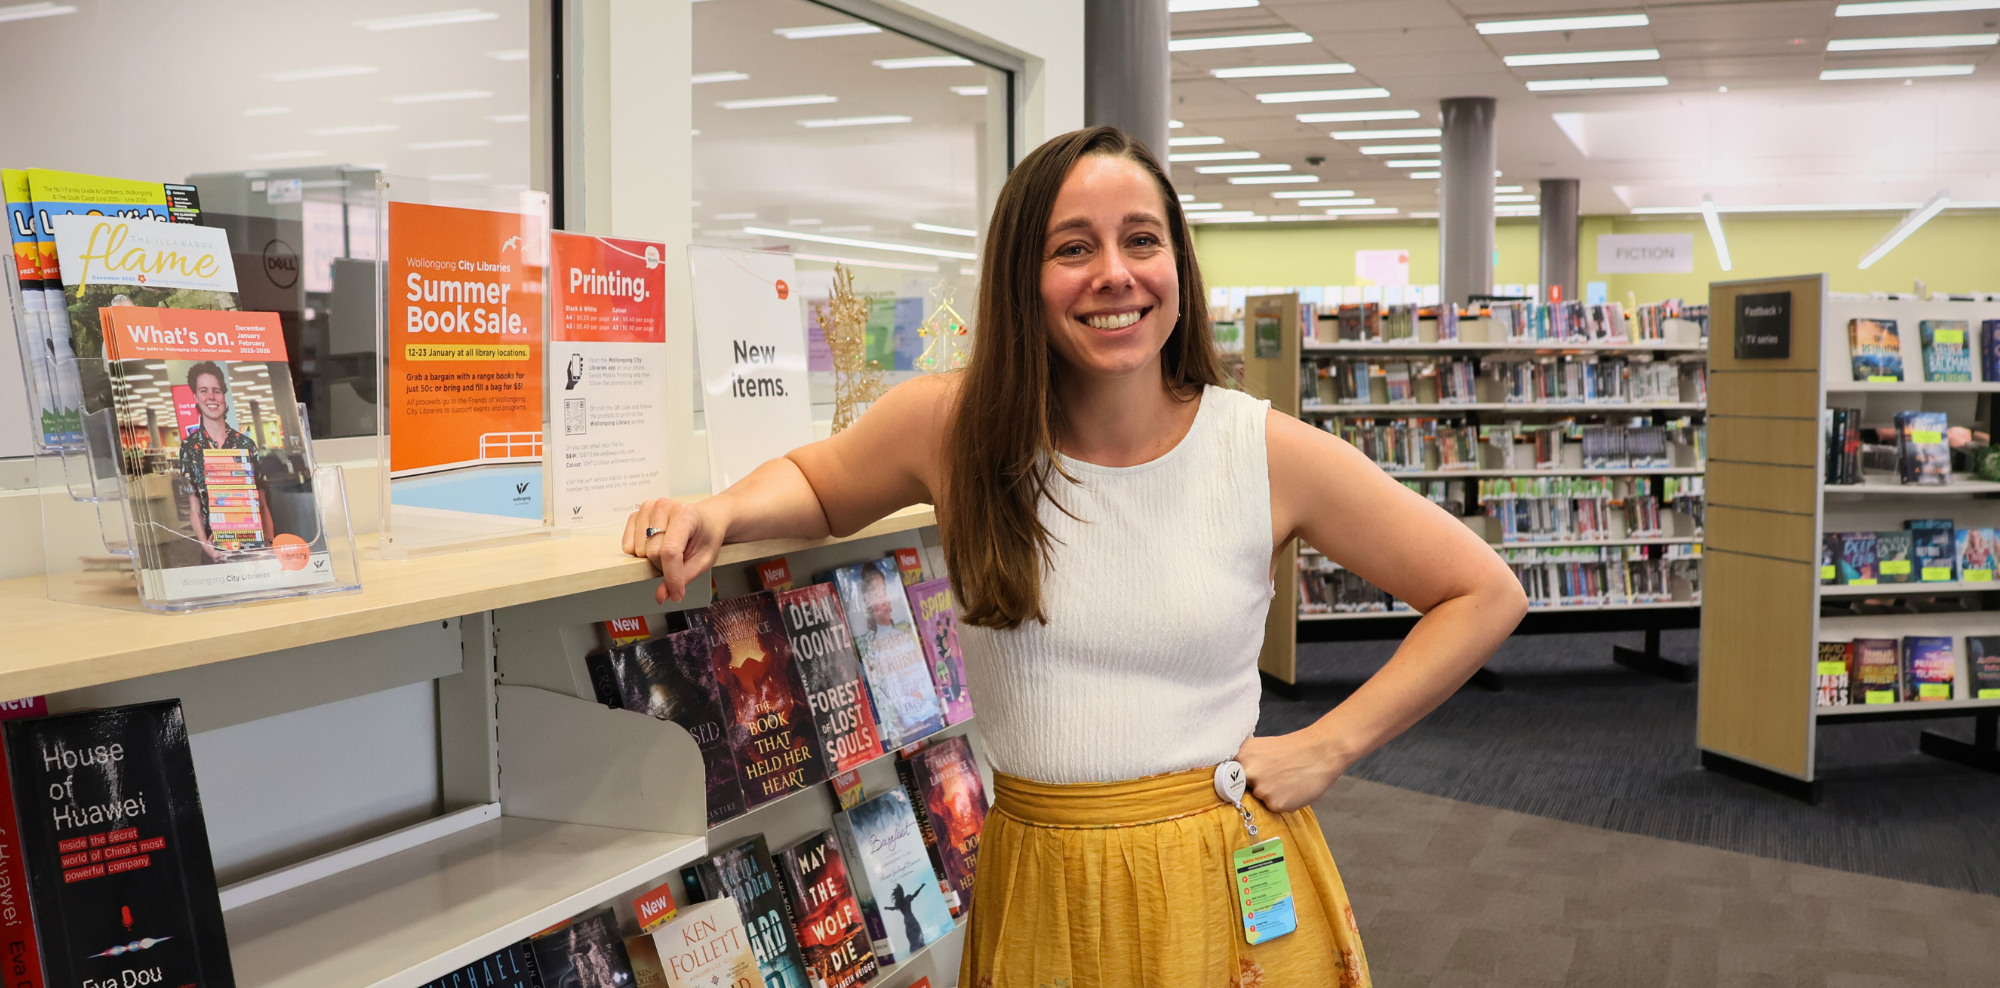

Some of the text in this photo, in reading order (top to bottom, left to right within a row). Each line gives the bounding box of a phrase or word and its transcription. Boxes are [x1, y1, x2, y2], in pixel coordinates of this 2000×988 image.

[131, 235, 214, 250] THE ILLAWARRA
[1616, 247, 1675, 260] FICTION
[20, 267, 34, 275] FREE
[76, 222, 219, 298] flame
[268, 258, 296, 271] DELL
[407, 257, 511, 272] Wollongong City Libraries
[407, 272, 510, 304] Summer
[570, 267, 650, 303] Printing.
[408, 305, 528, 334] Book Sale.
[1745, 306, 1776, 316] Fastback
[127, 325, 234, 346] What's on.
[1746, 335, 1778, 344] TV series
[408, 348, 427, 357] 12-23
[429, 349, 455, 358] January
[475, 349, 495, 358] library
[497, 349, 527, 357] locations.
[733, 340, 775, 364] New
[1929, 354, 1971, 372] BACKMAN
[406, 373, 422, 381] Grab
[430, 373, 454, 382] bargain
[457, 372, 470, 380] with
[496, 372, 514, 380] books
[406, 384, 418, 394] just
[444, 384, 460, 393] bring
[490, 383, 502, 392] bag
[731, 373, 788, 398] items.
[900, 554, 917, 566] New
[242, 572, 270, 580] Libraries
[764, 567, 785, 583] New
[612, 618, 640, 632] New
[789, 598, 833, 630] DEAN
[790, 624, 851, 662] KOONTZ
[755, 701, 771, 713] THE
[808, 679, 860, 717] FOREST
[748, 711, 789, 736] BOOK
[822, 704, 864, 736] OF LOST
[754, 731, 791, 754] THAT
[826, 728, 873, 763] SOULS
[42, 743, 124, 772] House
[745, 746, 812, 780] HELD HER
[762, 768, 807, 796] HEART
[836, 772, 855, 788] New
[929, 760, 968, 787] LAWRENCE
[50, 775, 73, 800] of
[53, 791, 146, 830] Huawei
[60, 830, 138, 851] Inside the secret
[62, 840, 163, 866] world of China's most
[959, 836, 979, 854] BOO
[798, 844, 827, 875] MAY
[65, 866, 104, 882] powerful
[960, 874, 975, 890] HEL
[733, 871, 772, 903] FADDEN
[808, 877, 837, 906] THE
[640, 895, 667, 919] New
[682, 915, 717, 947] KEN
[747, 910, 787, 963] ARD
[811, 905, 852, 943] WOLF
[10, 941, 26, 976] Eva
[524, 952, 536, 977] RUN
[669, 926, 740, 980] FOLLETT
[831, 941, 857, 972] DIE
[122, 966, 162, 988] Dou
[855, 961, 875, 978] HEIDER
